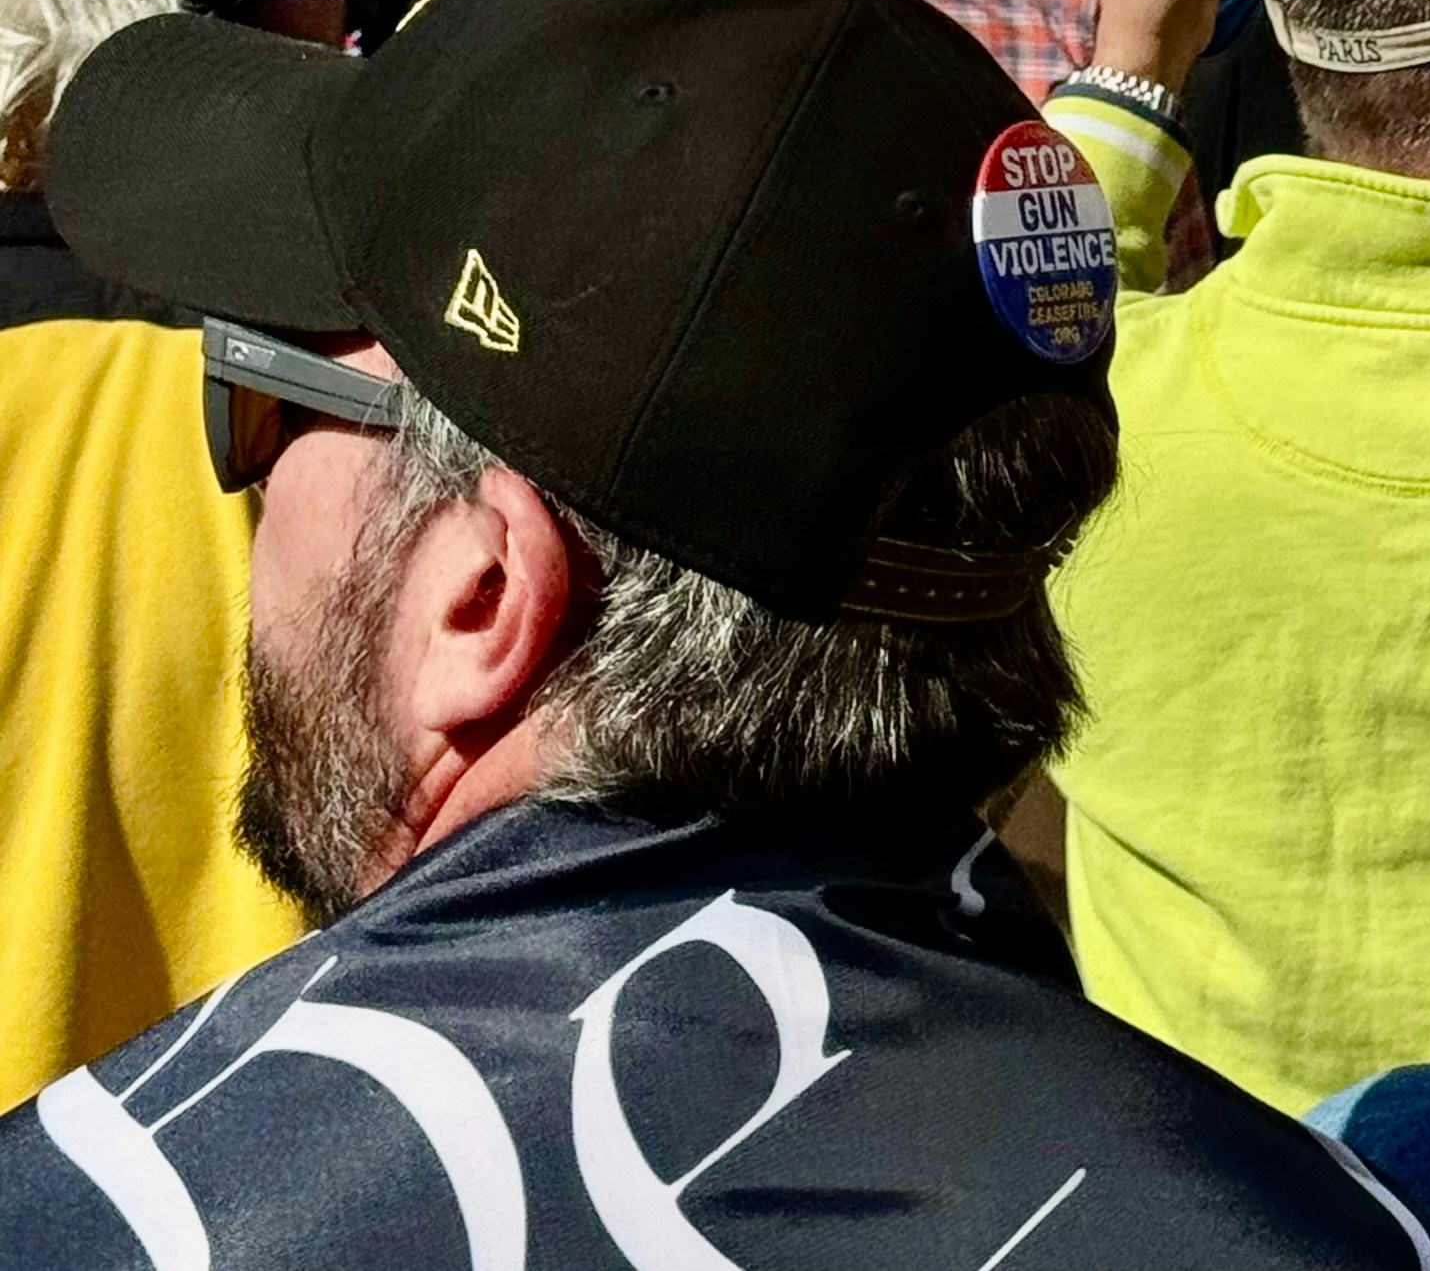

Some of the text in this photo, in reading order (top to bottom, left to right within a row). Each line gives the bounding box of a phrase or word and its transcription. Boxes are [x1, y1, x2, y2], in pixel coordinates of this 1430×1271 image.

[1315, 35, 1382, 64] PARIS
[1001, 143, 1076, 189] STOP
[1018, 188, 1080, 233] GUN
[989, 231, 1117, 278] VIOLENCE
[1027, 280, 1095, 304] COLORADO
[1027, 301, 1100, 326] CEASEFIRE
